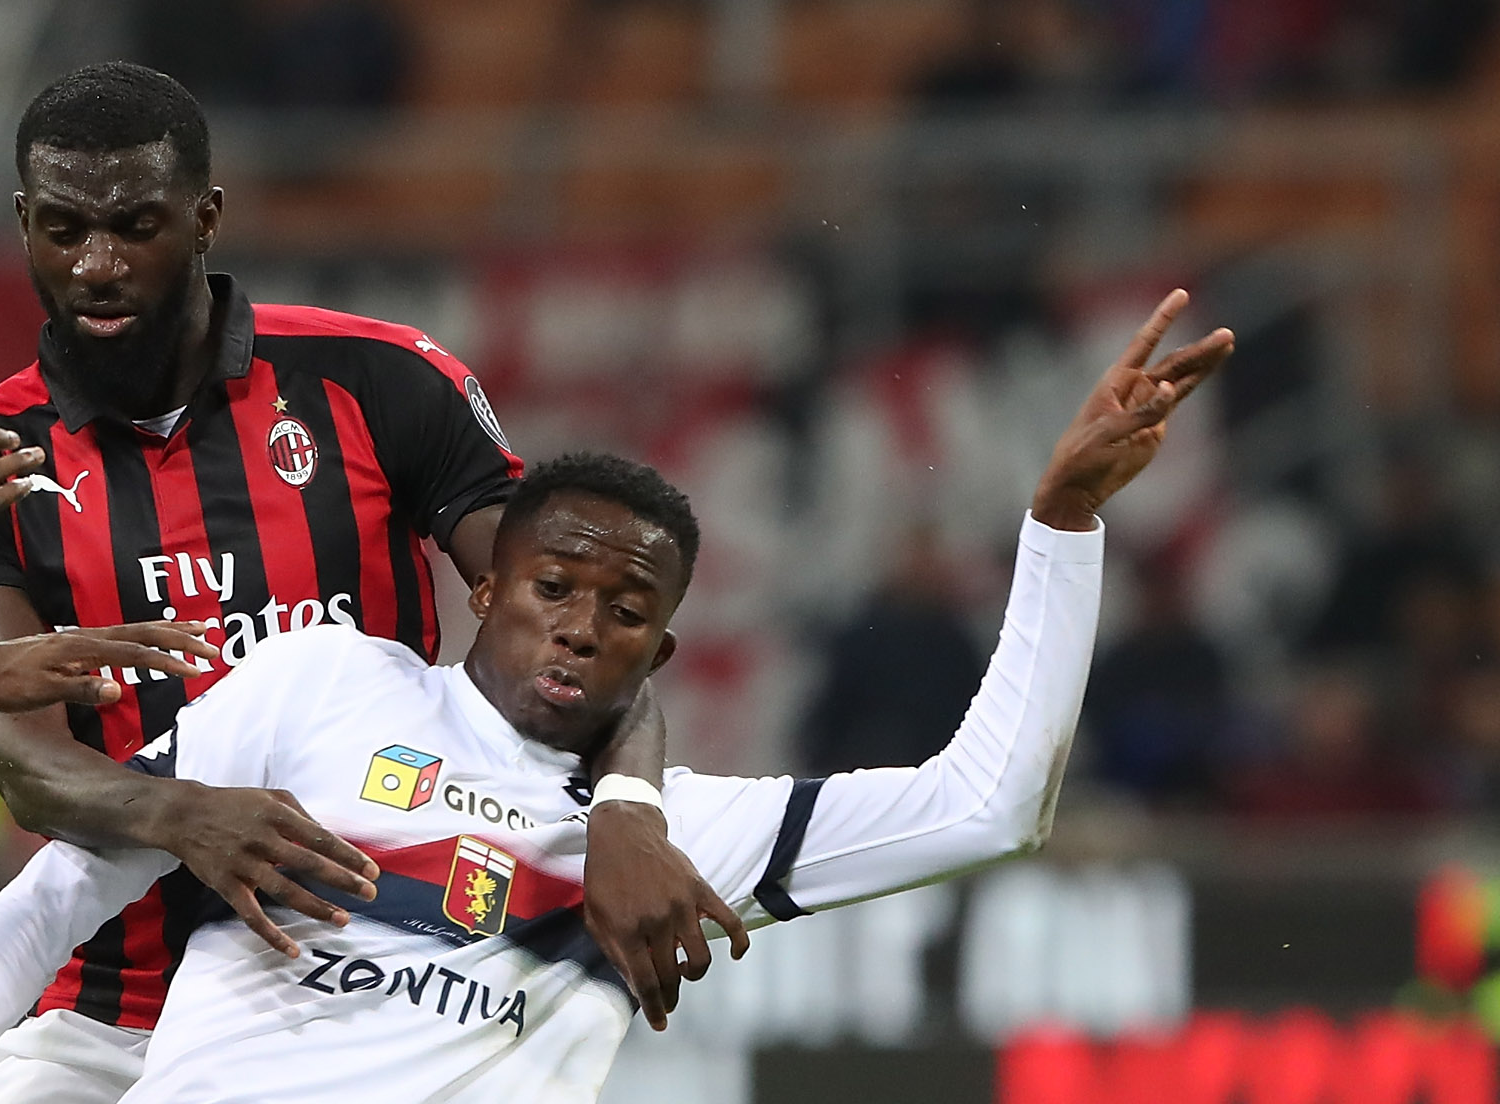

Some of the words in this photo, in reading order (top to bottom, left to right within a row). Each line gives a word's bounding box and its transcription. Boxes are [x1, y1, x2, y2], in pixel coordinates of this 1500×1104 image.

[273, 422, 301, 438] ACM
[285, 469, 309, 481] 1899
[138, 552, 234, 602] Fly
[298, 948, 527, 1037] ZONTIVA
